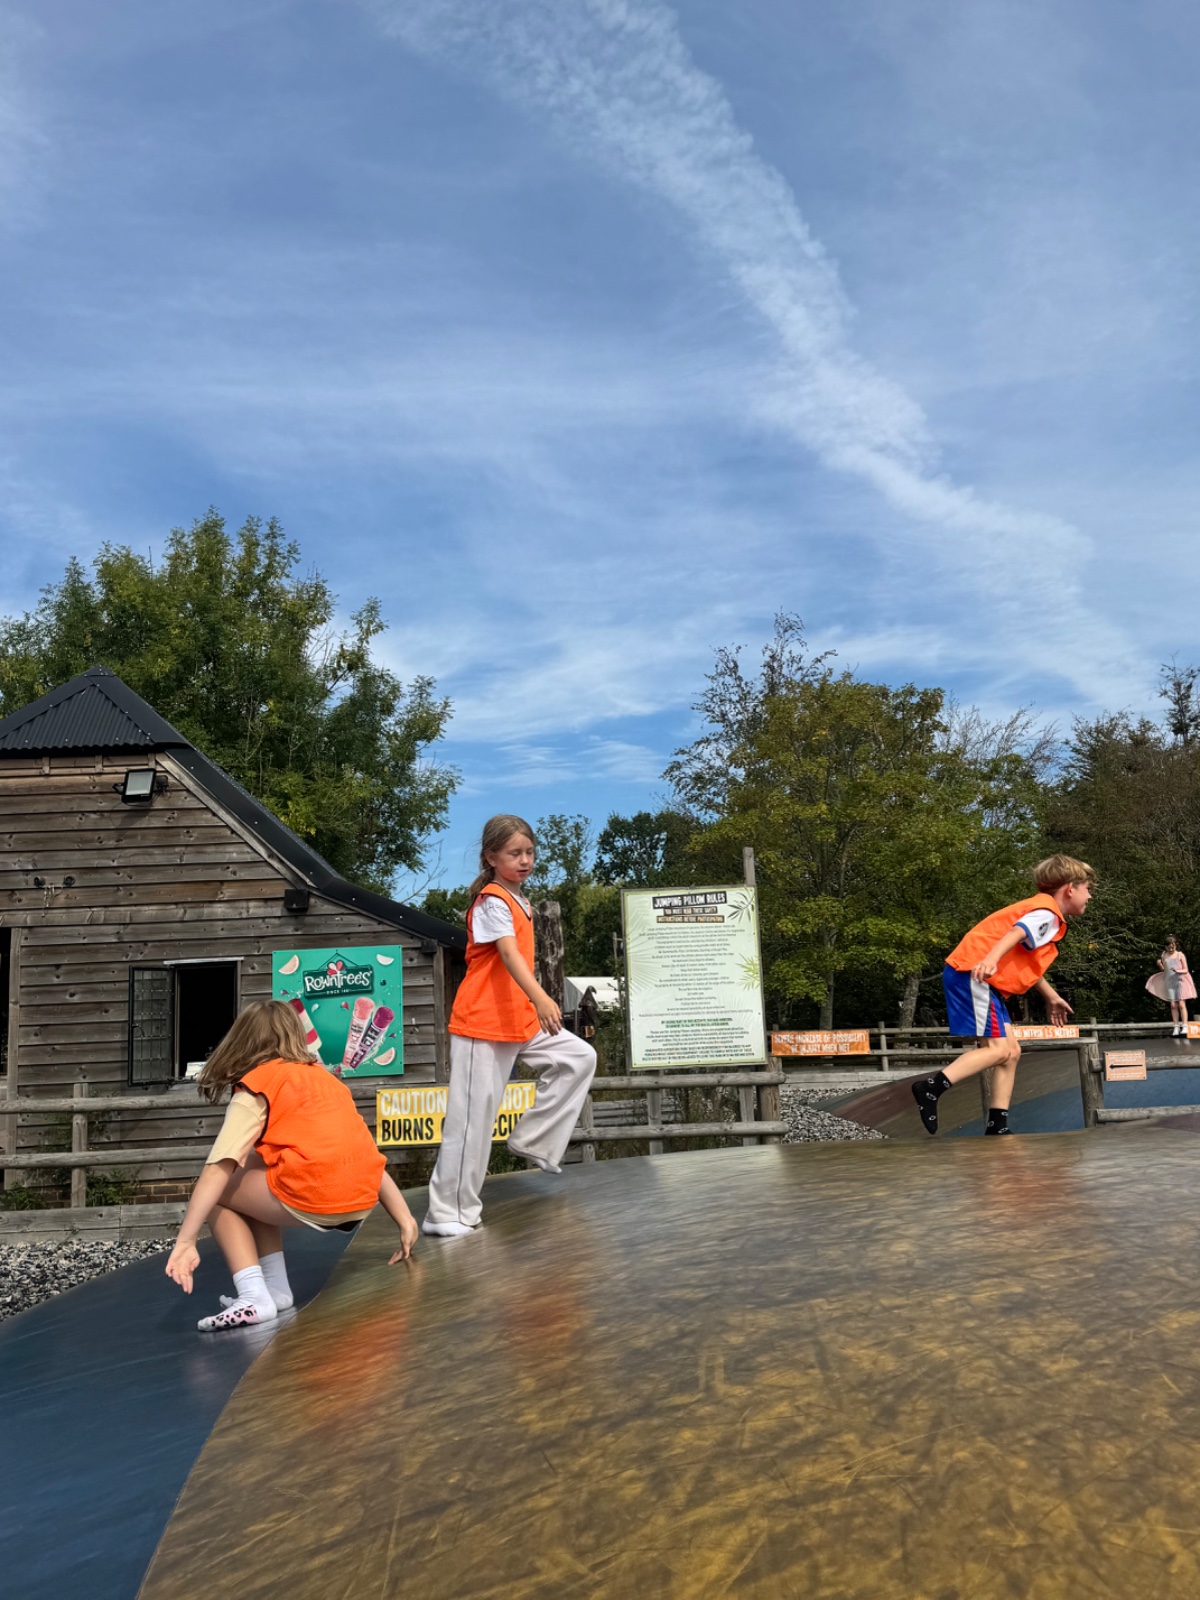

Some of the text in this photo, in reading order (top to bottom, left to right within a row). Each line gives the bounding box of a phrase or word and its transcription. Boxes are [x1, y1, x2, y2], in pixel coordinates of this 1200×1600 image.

[654, 893, 725, 908] JUMPING PILLOW RULES
[824, 1034, 831, 1043] OF
[833, 1033, 865, 1042] POSSIBILITY
[800, 1044, 820, 1053] INJURY
[822, 1044, 837, 1052] WHEN
[839, 1043, 850, 1052] WET
[380, 1086, 532, 1116] CAUTION HOT
[382, 1117, 434, 1142] BURNS
